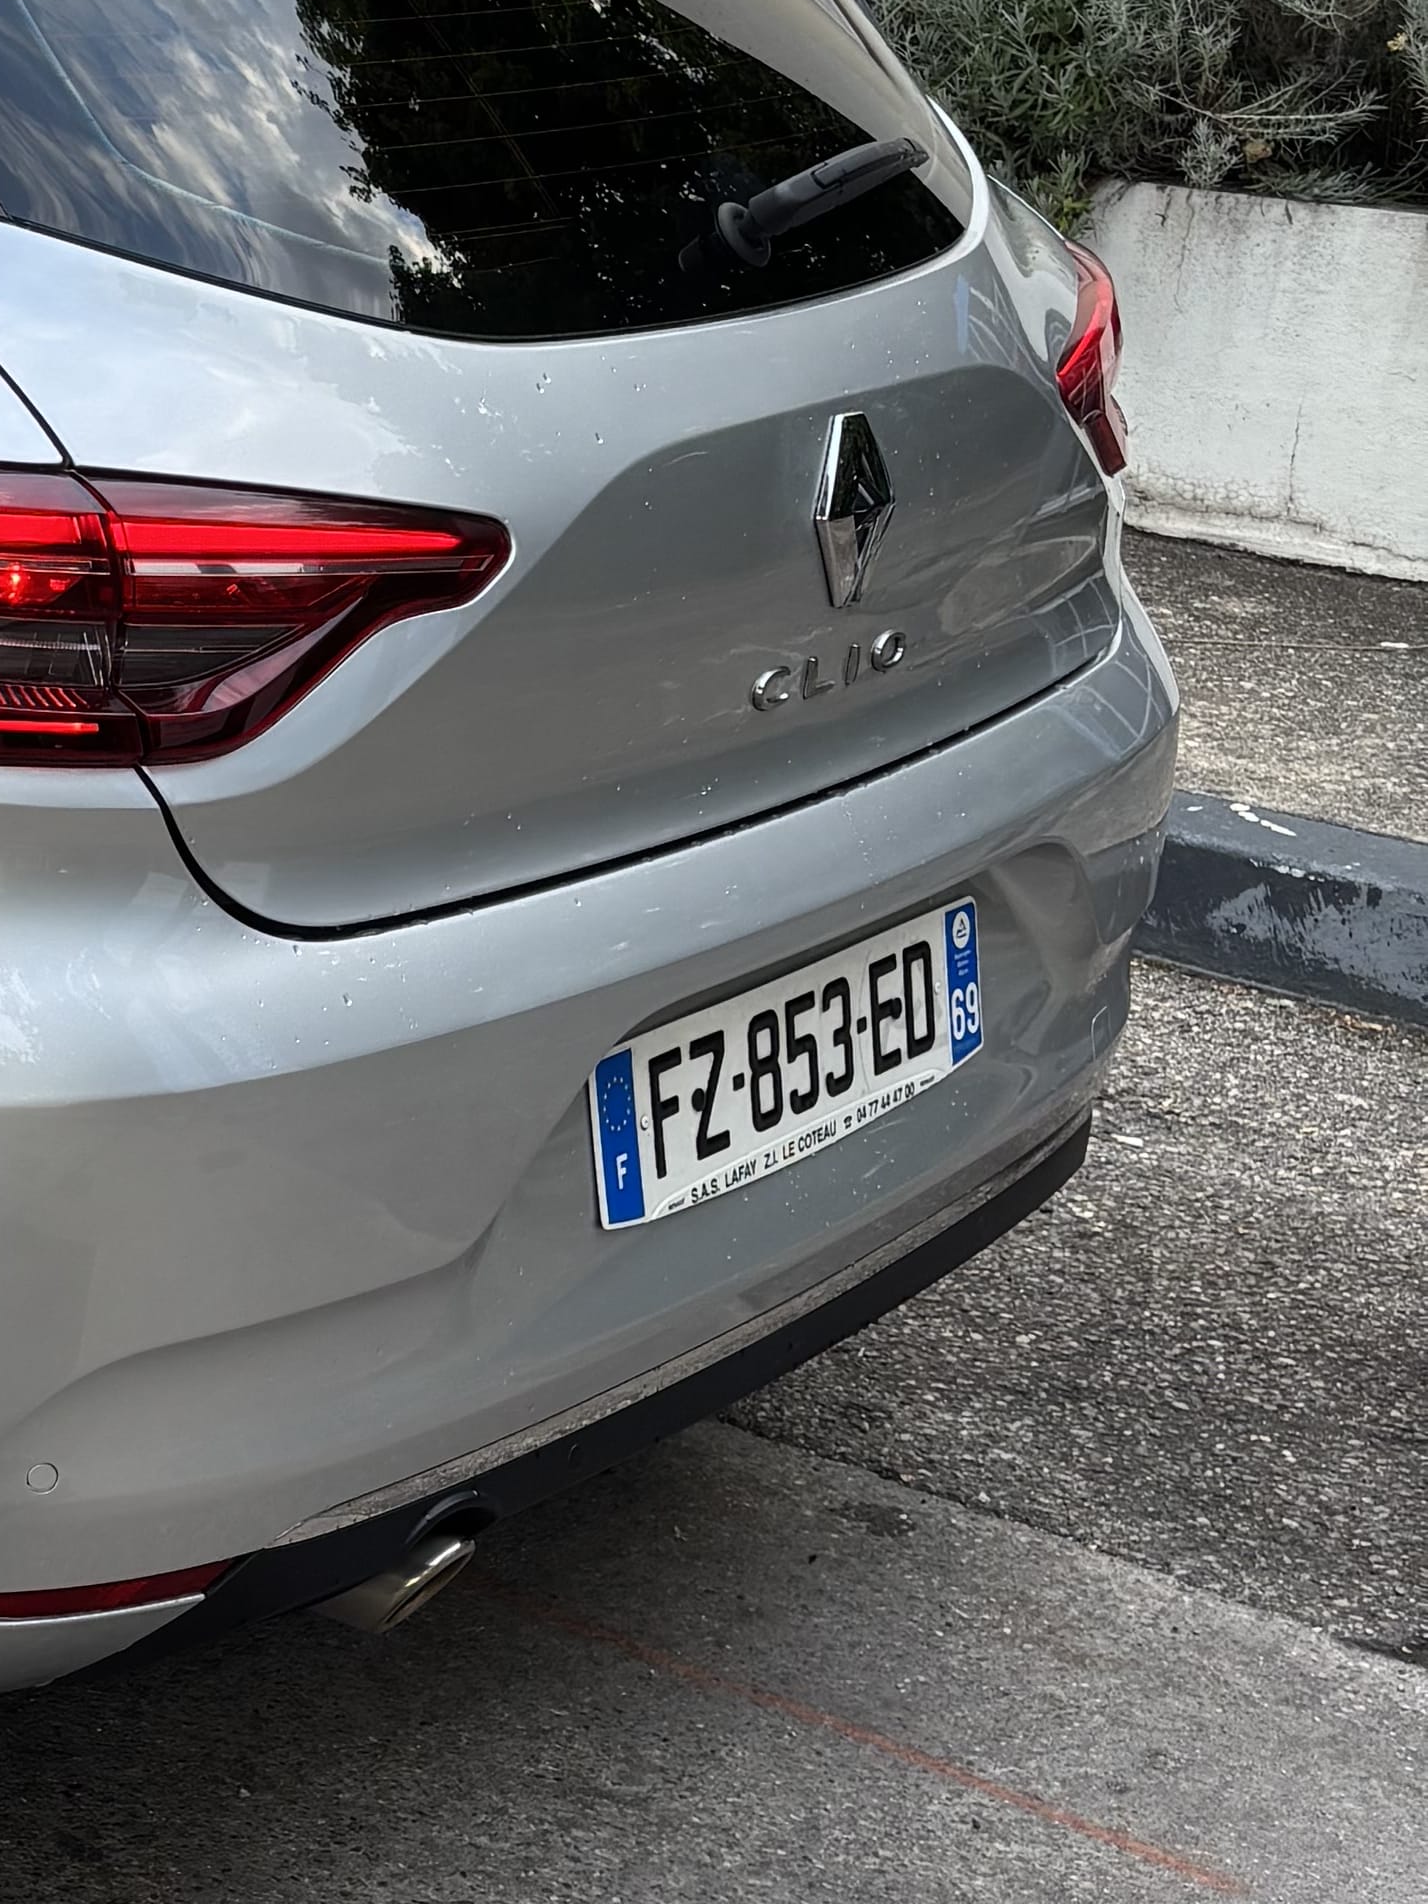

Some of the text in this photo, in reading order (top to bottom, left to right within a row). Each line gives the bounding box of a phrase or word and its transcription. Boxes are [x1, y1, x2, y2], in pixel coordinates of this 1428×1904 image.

[749, 629, 907, 713] CLIO
[616, 1152, 629, 1191] F
[649, 939, 936, 1180] FZ-853-ED
[950, 981, 980, 1041] 69
[690, 1179, 721, 1204] S.A.S.
[725, 1159, 758, 1189] LAFAY
[782, 1140, 795, 1160] LE
[798, 1119, 837, 1153] COTEAU
[856, 1105, 867, 1124] 04
[868, 1099, 880, 1118] 77
[880, 1093, 891, 1112] 44
[892, 1087, 904, 1106] 47
[904, 1082, 916, 1101] 00
